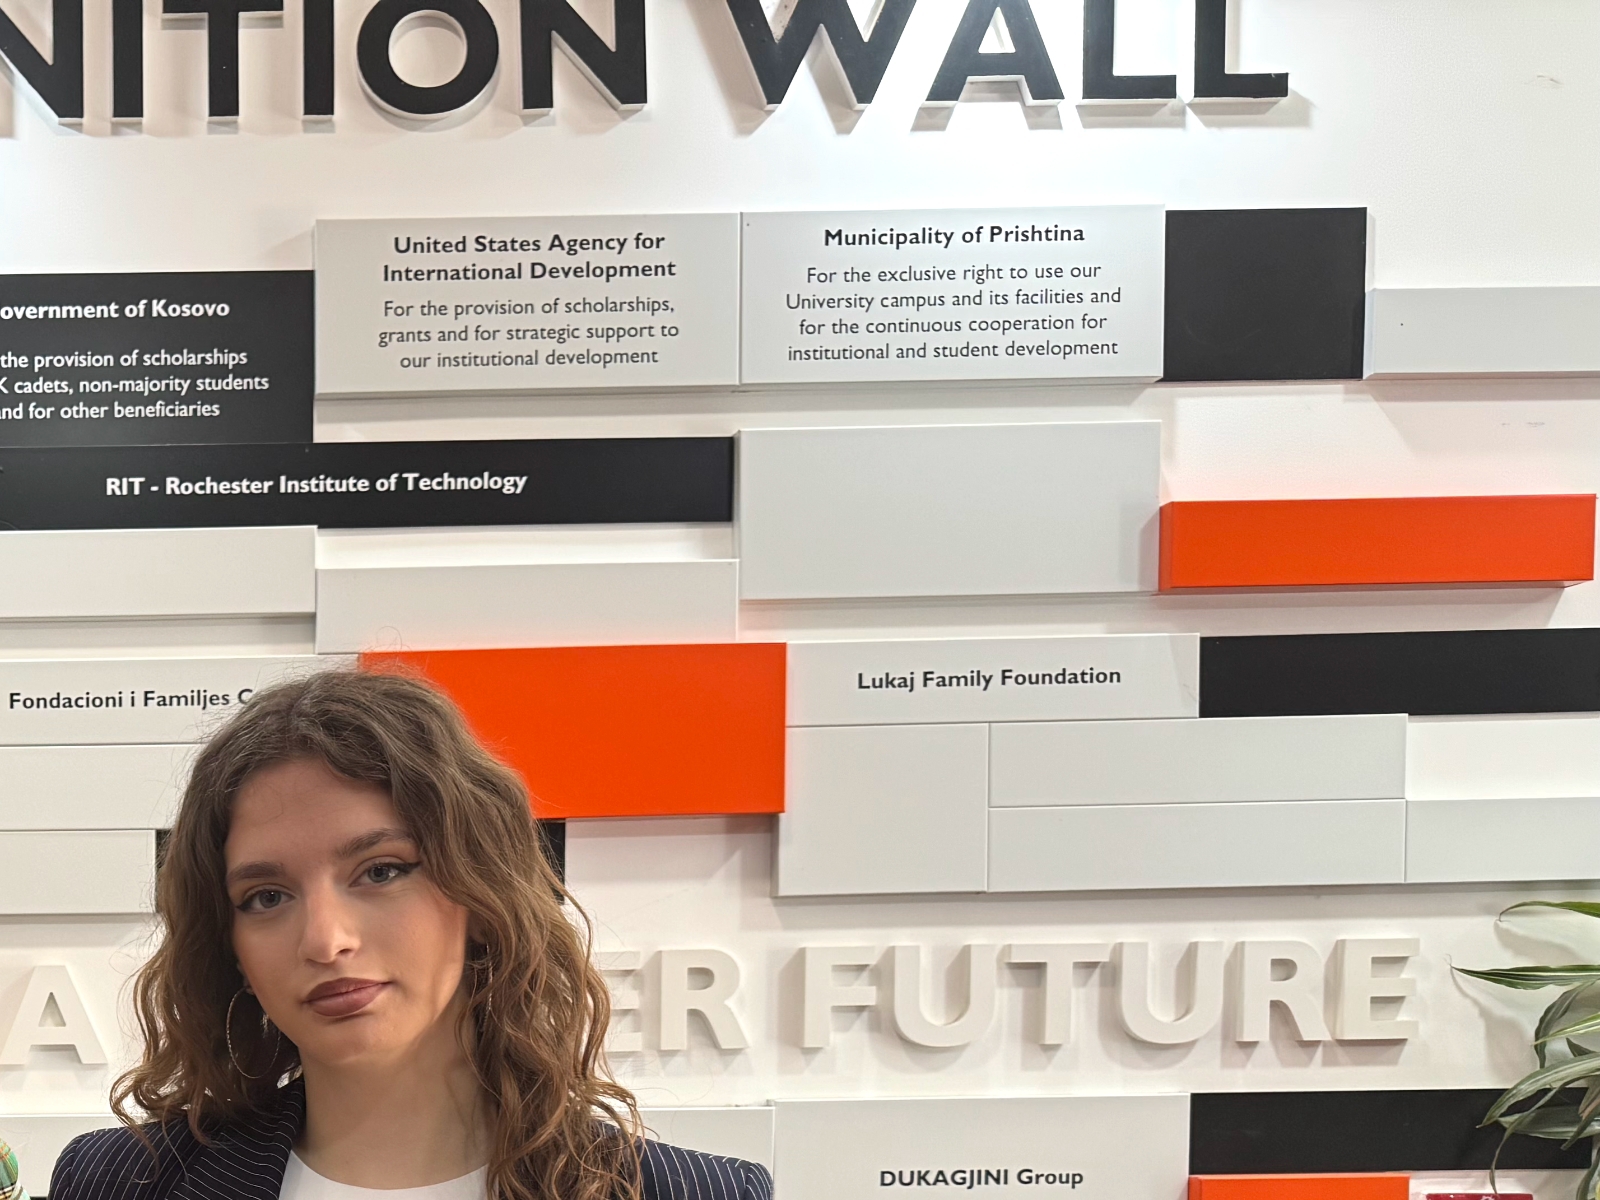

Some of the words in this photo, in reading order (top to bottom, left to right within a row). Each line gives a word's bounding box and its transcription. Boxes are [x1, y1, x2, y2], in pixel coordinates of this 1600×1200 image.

[725, 0, 1290, 105] WALL
[394, 235, 467, 254] United
[474, 235, 541, 253] States
[547, 233, 628, 257] Agency
[633, 232, 666, 250] for
[824, 226, 955, 251] Municipality
[961, 225, 984, 244] of
[989, 224, 1086, 243] Prishtina
[383, 262, 522, 282] International
[530, 260, 677, 284] Development
[807, 266, 838, 284] For
[843, 266, 872, 283] the
[877, 265, 957, 282] exclusive
[963, 263, 1004, 285] right
[1009, 267, 1028, 280] to
[1035, 266, 1064, 279] use
[1070, 266, 1102, 278] our
[124, 299, 148, 318] of
[151, 298, 230, 318] Kosovo
[384, 300, 415, 317] For
[419, 299, 449, 317] the
[454, 299, 535, 321] provision
[541, 297, 561, 314] of
[564, 295, 675, 317] scholarships,
[786, 293, 875, 313] University
[880, 295, 946, 312] campus
[951, 289, 983, 307] and
[989, 290, 1009, 306] its
[1015, 287, 1084, 305] facilities
[1090, 286, 1121, 304] and
[378, 330, 432, 348] grants
[437, 324, 469, 342] and
[473, 324, 501, 342] for
[506, 323, 581, 345] strategic
[586, 325, 656, 344] support
[660, 325, 680, 338] to
[0, 350, 29, 369] the
[33, 351, 115, 373] provision
[119, 348, 140, 367] of
[142, 348, 248, 370] scholarships
[13, 376, 74, 396] cadets,
[79, 375, 192, 397] non-majority
[195, 373, 270, 391] students
[106, 477, 146, 496] RIT
[165, 476, 274, 495] Rochester
[279, 474, 370, 494] Institute
[375, 472, 400, 492] of
[401, 471, 528, 495] Technology
[857, 671, 915, 693] Lukaj
[922, 669, 994, 692] Family
[1001, 666, 1121, 686] Foundation
[9, 690, 123, 710] Fondacioni
[130, 690, 135, 708] i
[143, 689, 230, 711] Familjes
[801, 936, 1420, 1050] FUTURE
[879, 1168, 1009, 1190] DUKAGJINI
[1016, 1168, 1084, 1190] Group
